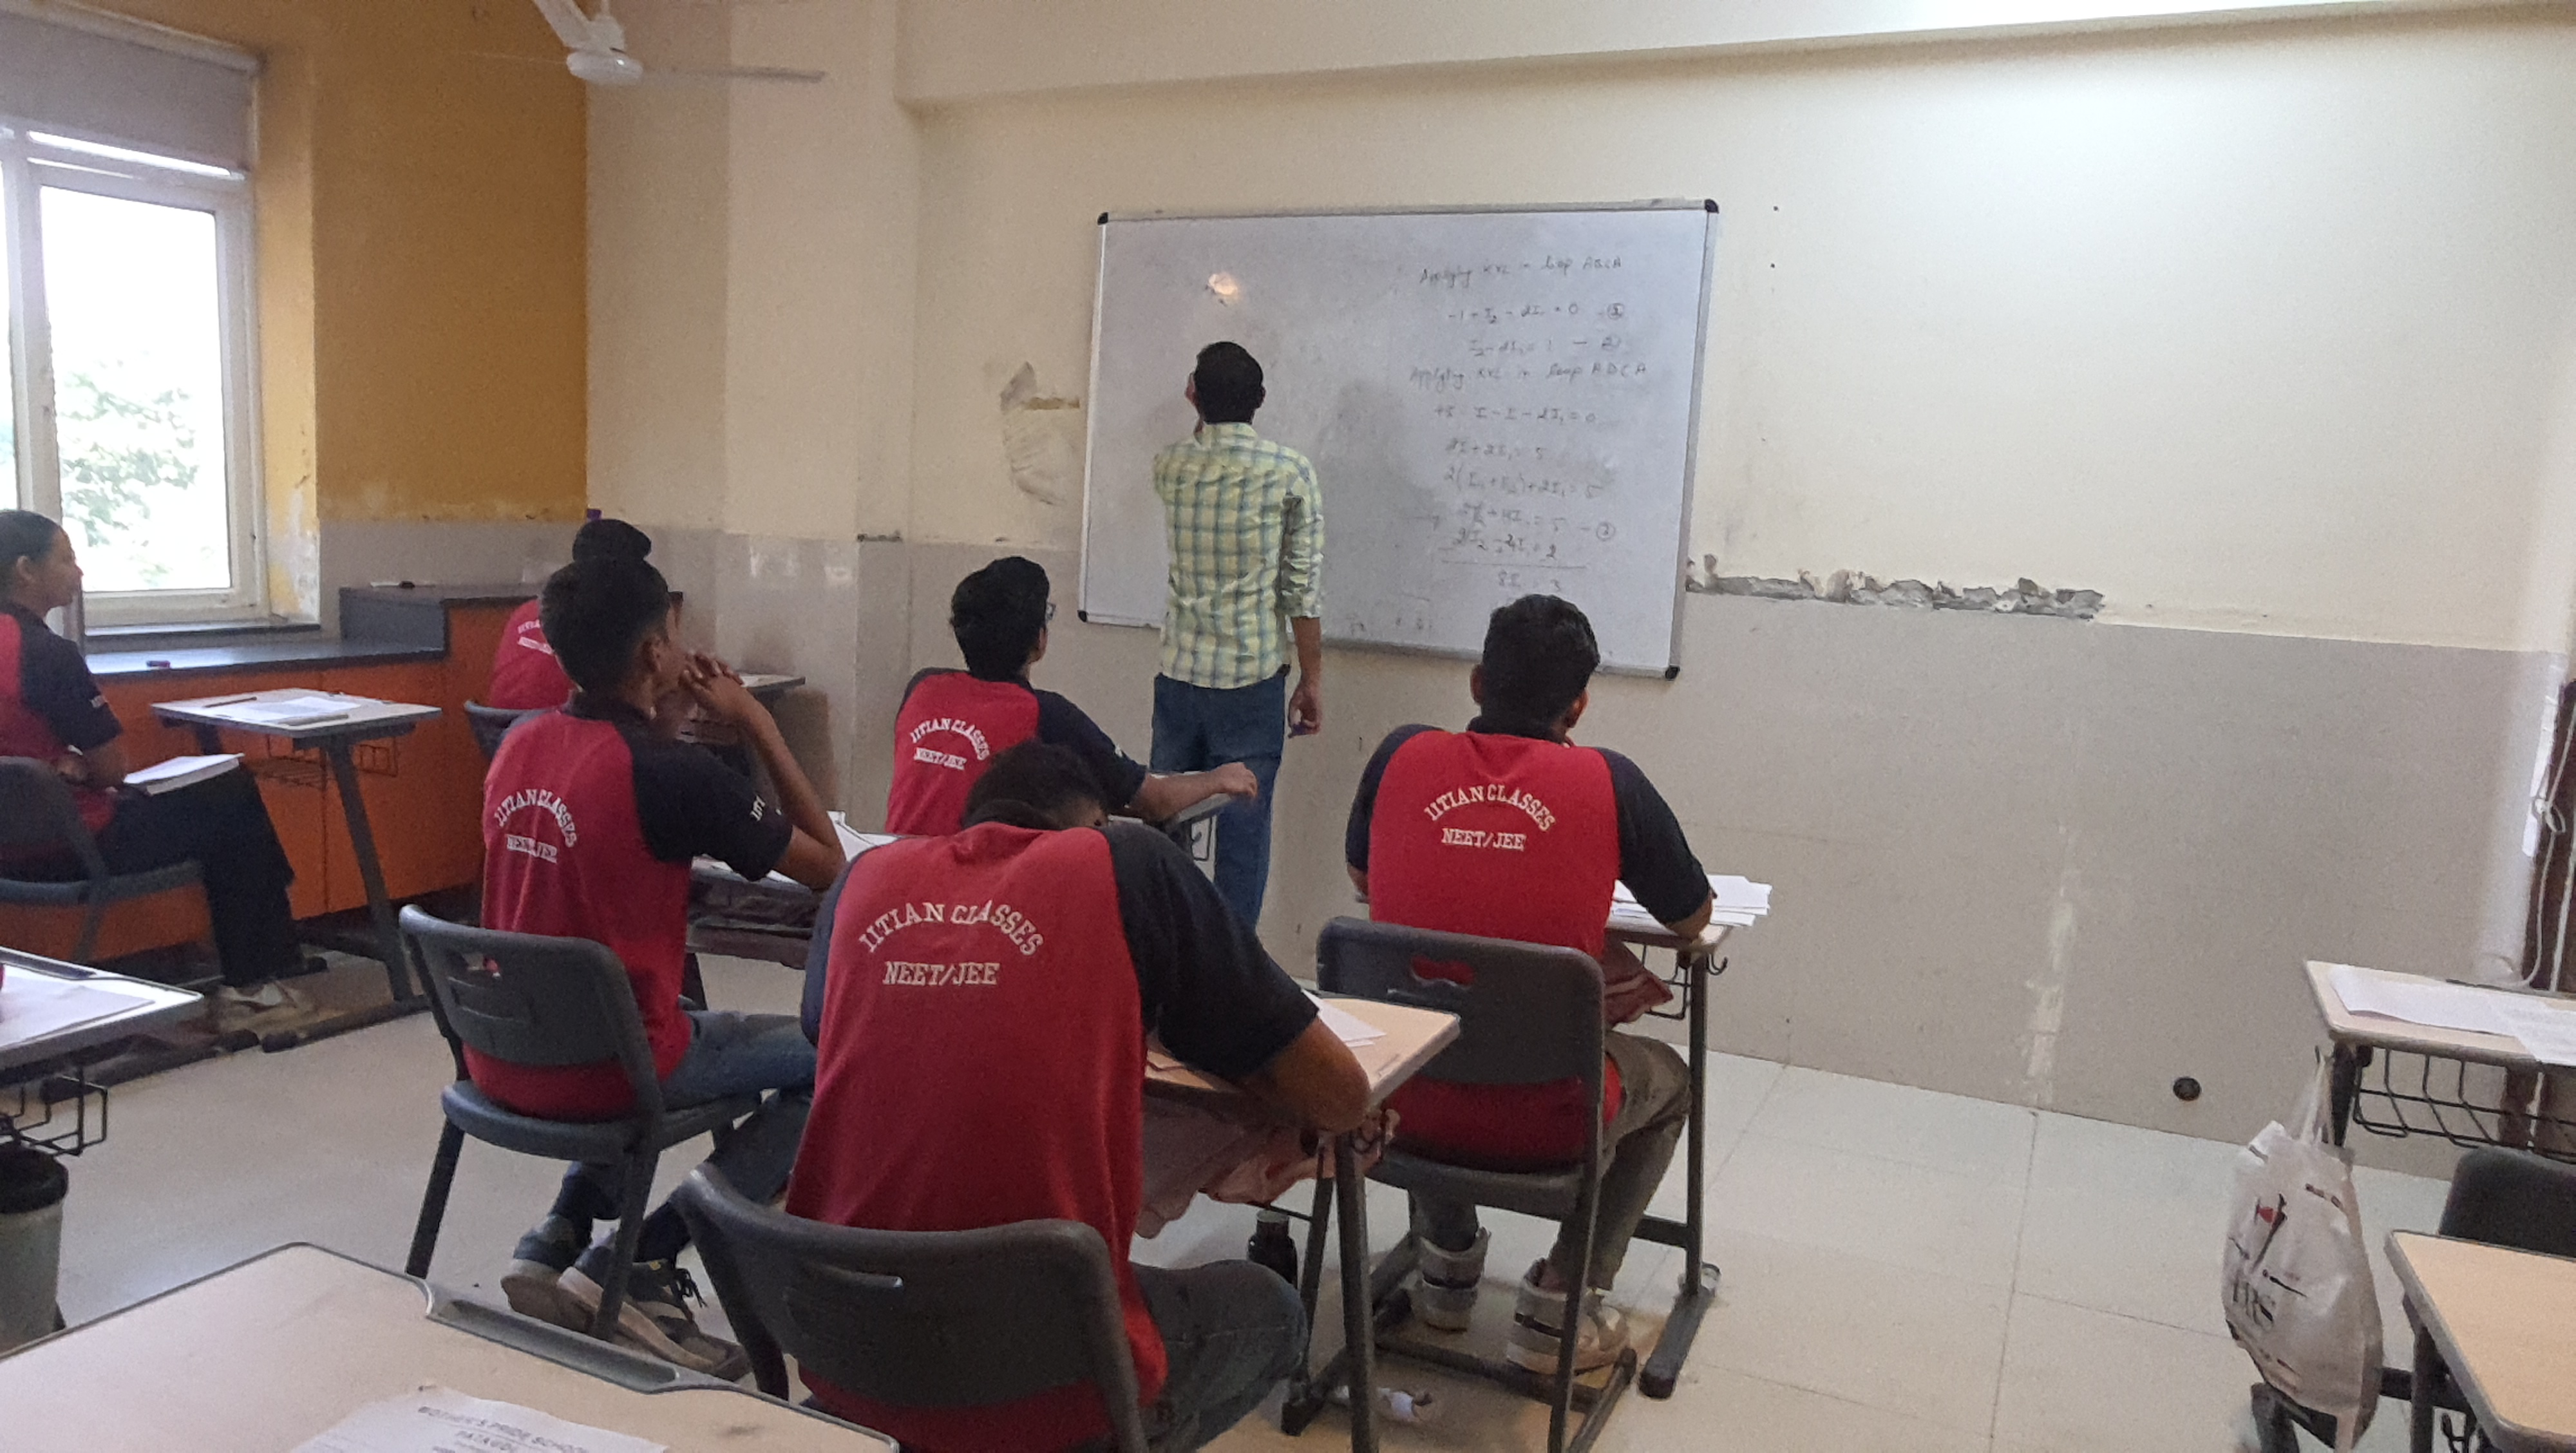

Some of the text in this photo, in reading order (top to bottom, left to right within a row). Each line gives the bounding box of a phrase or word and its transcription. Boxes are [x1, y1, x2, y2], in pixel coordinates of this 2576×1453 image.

[1423, 784, 1556, 832] IITIAN CLASSES
[1441, 828, 1527, 851] NEET/JEE
[858, 900, 1045, 956] IITIAN CLASSES
[882, 960, 1000, 987] NEET/JEE
